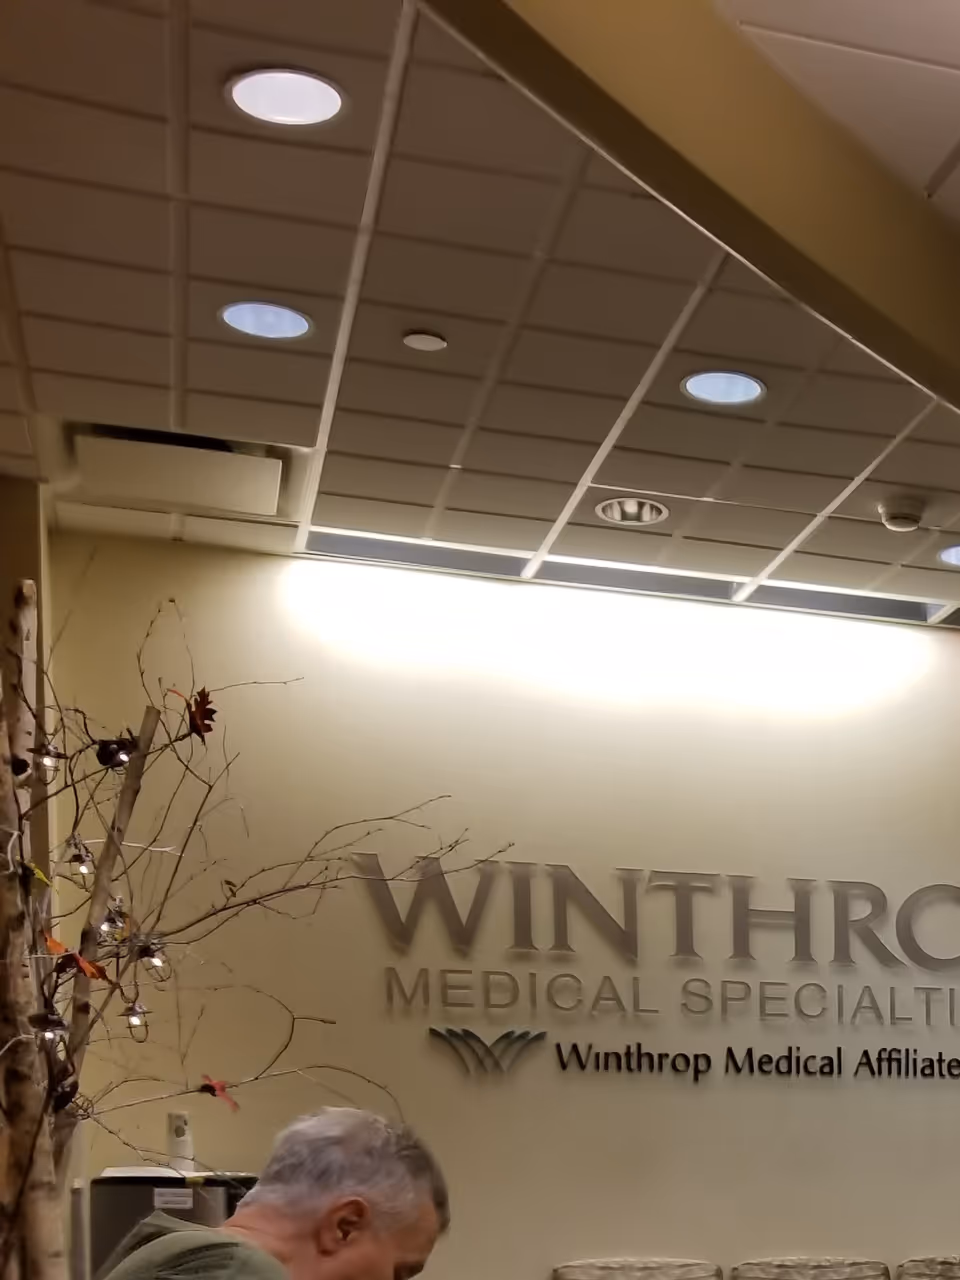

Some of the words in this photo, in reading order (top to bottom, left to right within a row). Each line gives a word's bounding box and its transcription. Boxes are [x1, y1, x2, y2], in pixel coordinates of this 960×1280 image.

[385, 966, 660, 1014] MEDICAL
[555, 1042, 712, 1082] Winthrop
[724, 1046, 842, 1077] Medical
